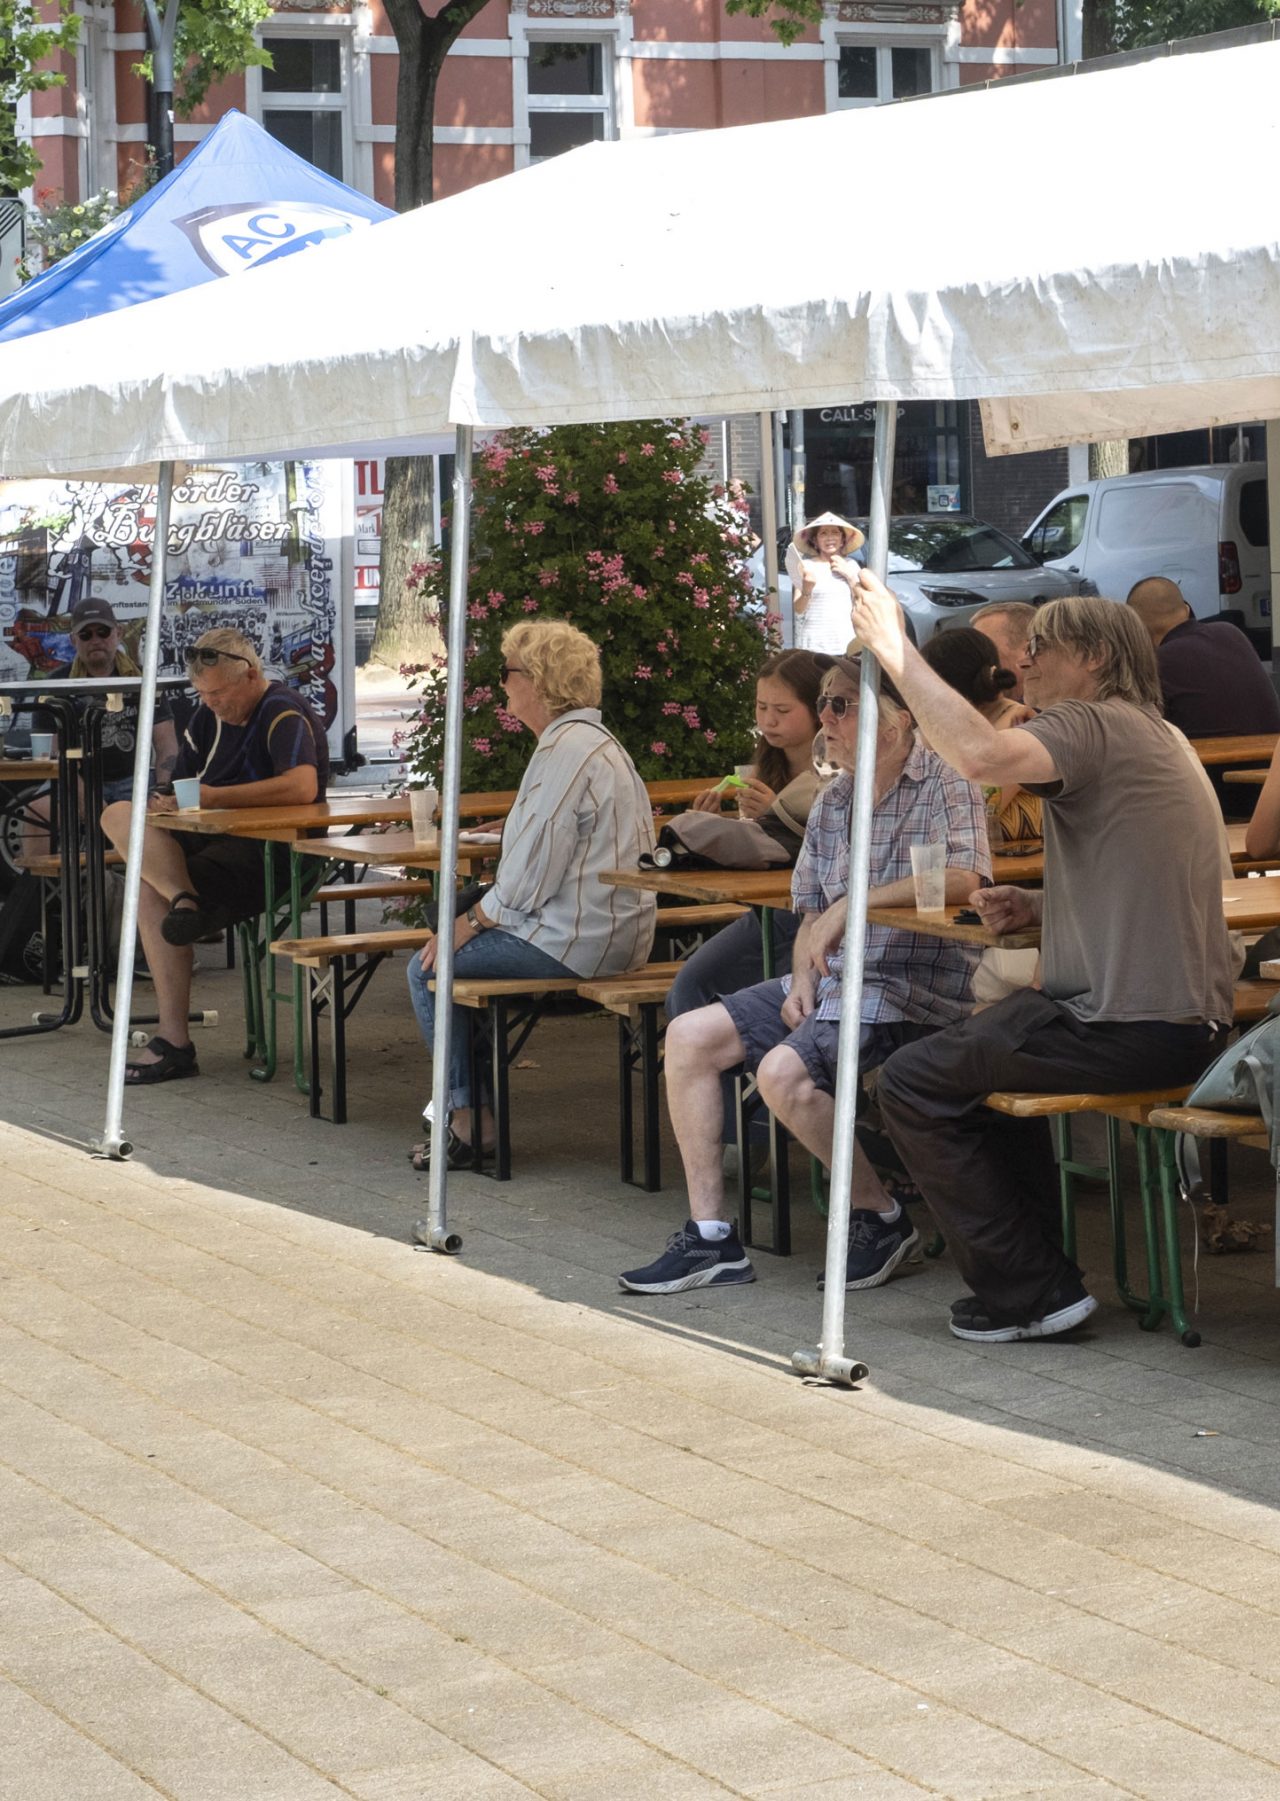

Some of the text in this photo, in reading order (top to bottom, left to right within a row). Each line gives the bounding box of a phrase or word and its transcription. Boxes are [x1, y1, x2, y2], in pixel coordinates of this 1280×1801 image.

[222, 214, 296, 259] AC
[820, 408, 905, 422] CALL-SP
[166, 580, 255, 599] Zukunft
